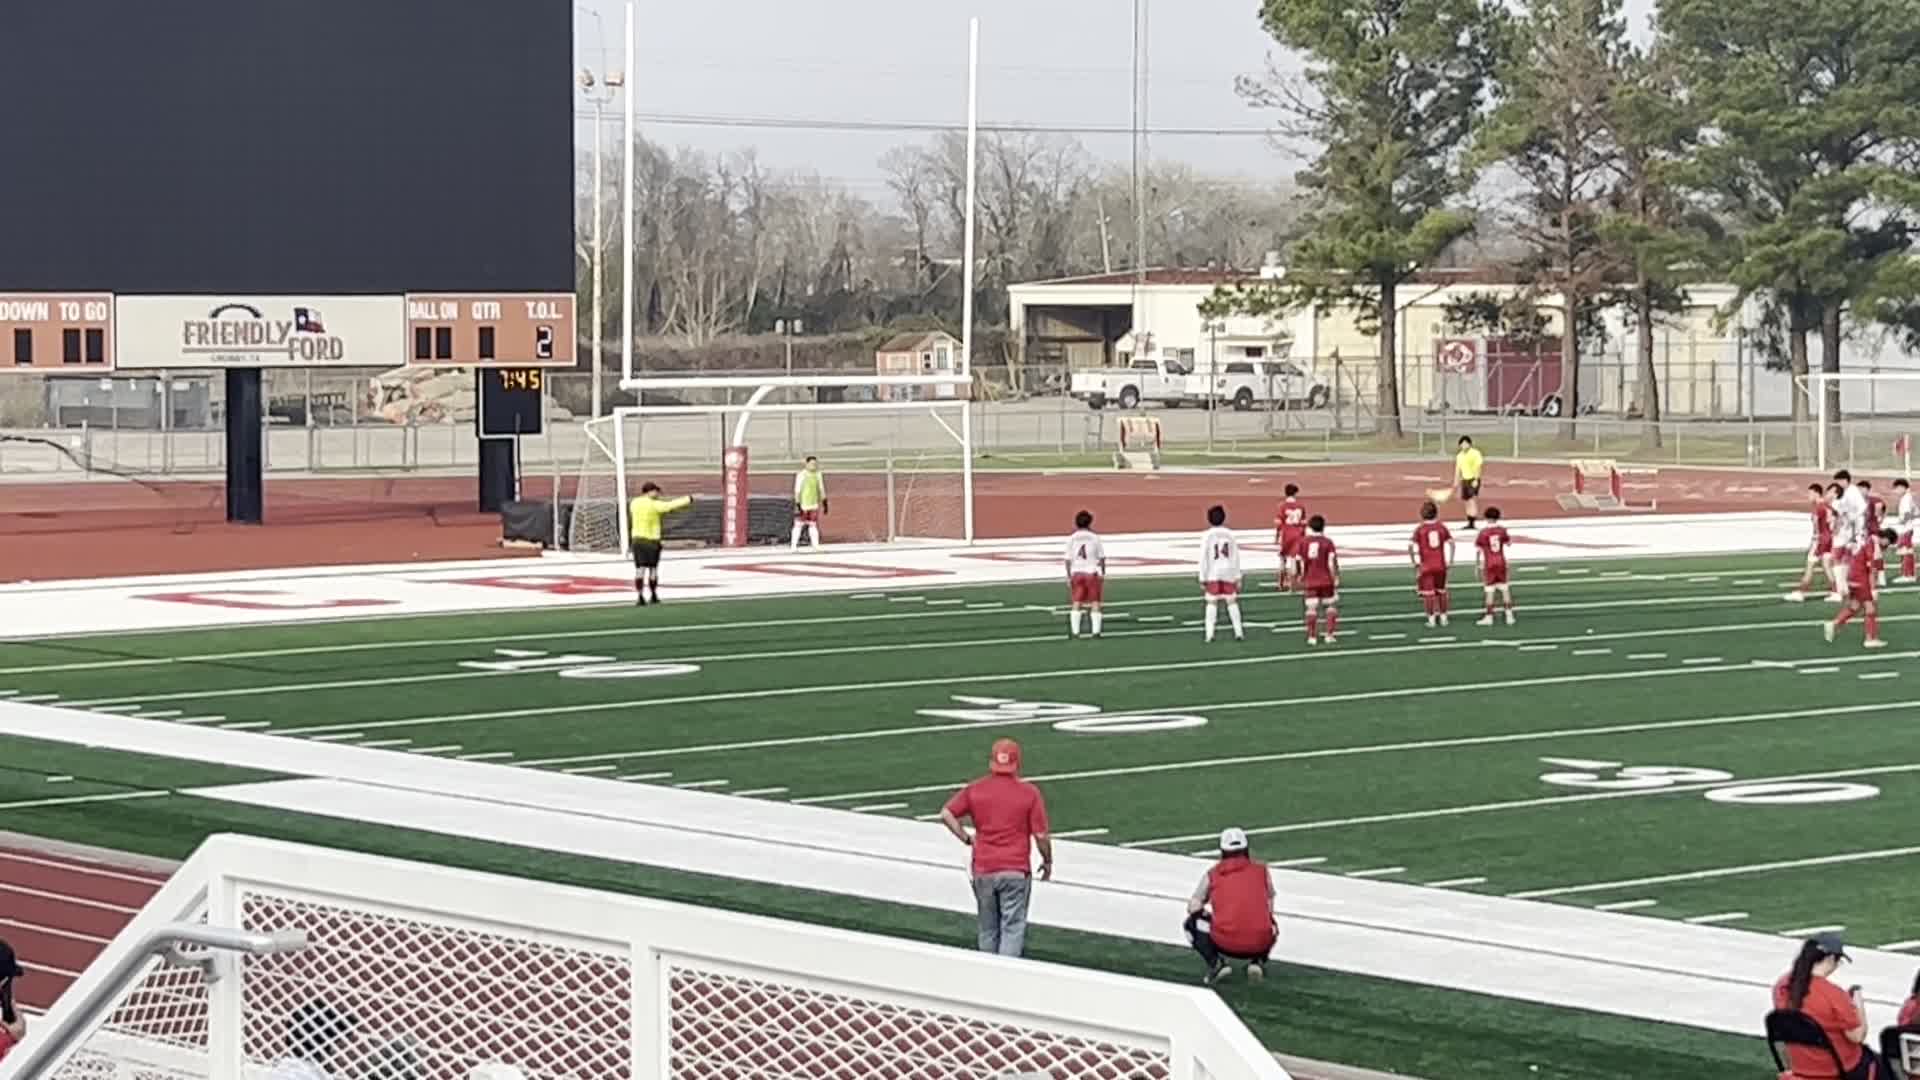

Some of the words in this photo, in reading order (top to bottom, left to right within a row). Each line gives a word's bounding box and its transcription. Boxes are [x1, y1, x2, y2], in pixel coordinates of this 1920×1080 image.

[60, 302, 80, 320] TO
[85, 302, 106, 320] GO
[409, 302, 438, 319] BALL
[440, 302, 458, 319] ON
[472, 302, 501, 319] QTR
[184, 320, 292, 345] FRIENDLY
[537, 326, 551, 357] 2
[288, 336, 343, 361] FORD
[500, 370, 540, 390] 7:45
[1077, 543, 1088, 560] 4
[1213, 541, 1230, 560] 14
[1539, 764, 1881, 804] 30
